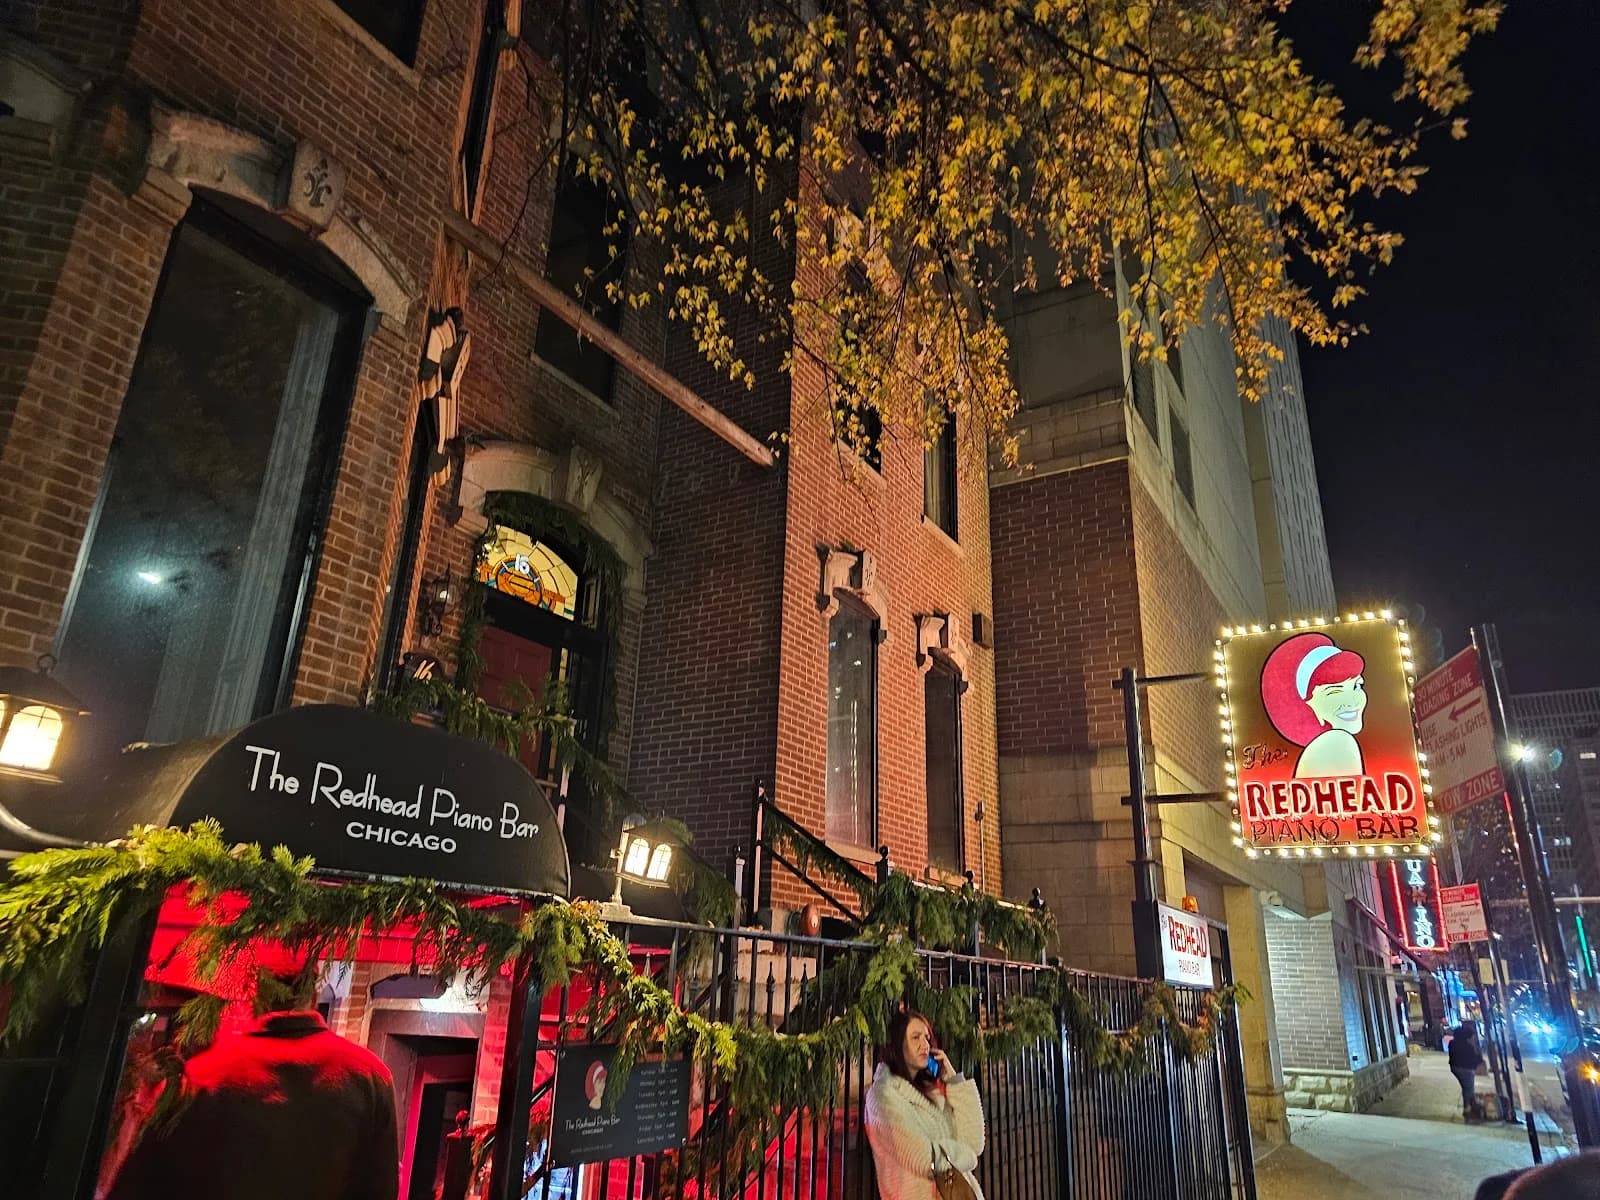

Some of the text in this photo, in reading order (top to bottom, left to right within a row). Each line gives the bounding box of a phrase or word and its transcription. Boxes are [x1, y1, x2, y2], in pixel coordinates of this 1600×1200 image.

[1420, 672, 1474, 716] LOADING ZONE
[1427, 667, 1455, 697] MINUTE
[1423, 723, 1437, 740] USE
[1460, 713, 1488, 736] LIGHTS
[1243, 744, 1288, 769] The
[245, 745, 539, 840] The Redhead Piano Bar
[1245, 772, 1416, 821] REDHEAD
[1437, 771, 1500, 813] TOW ZONE
[346, 821, 457, 854] CHICAGO
[1250, 816, 1419, 842] PIANO BAR
[1168, 915, 1208, 958] REDHEAD
